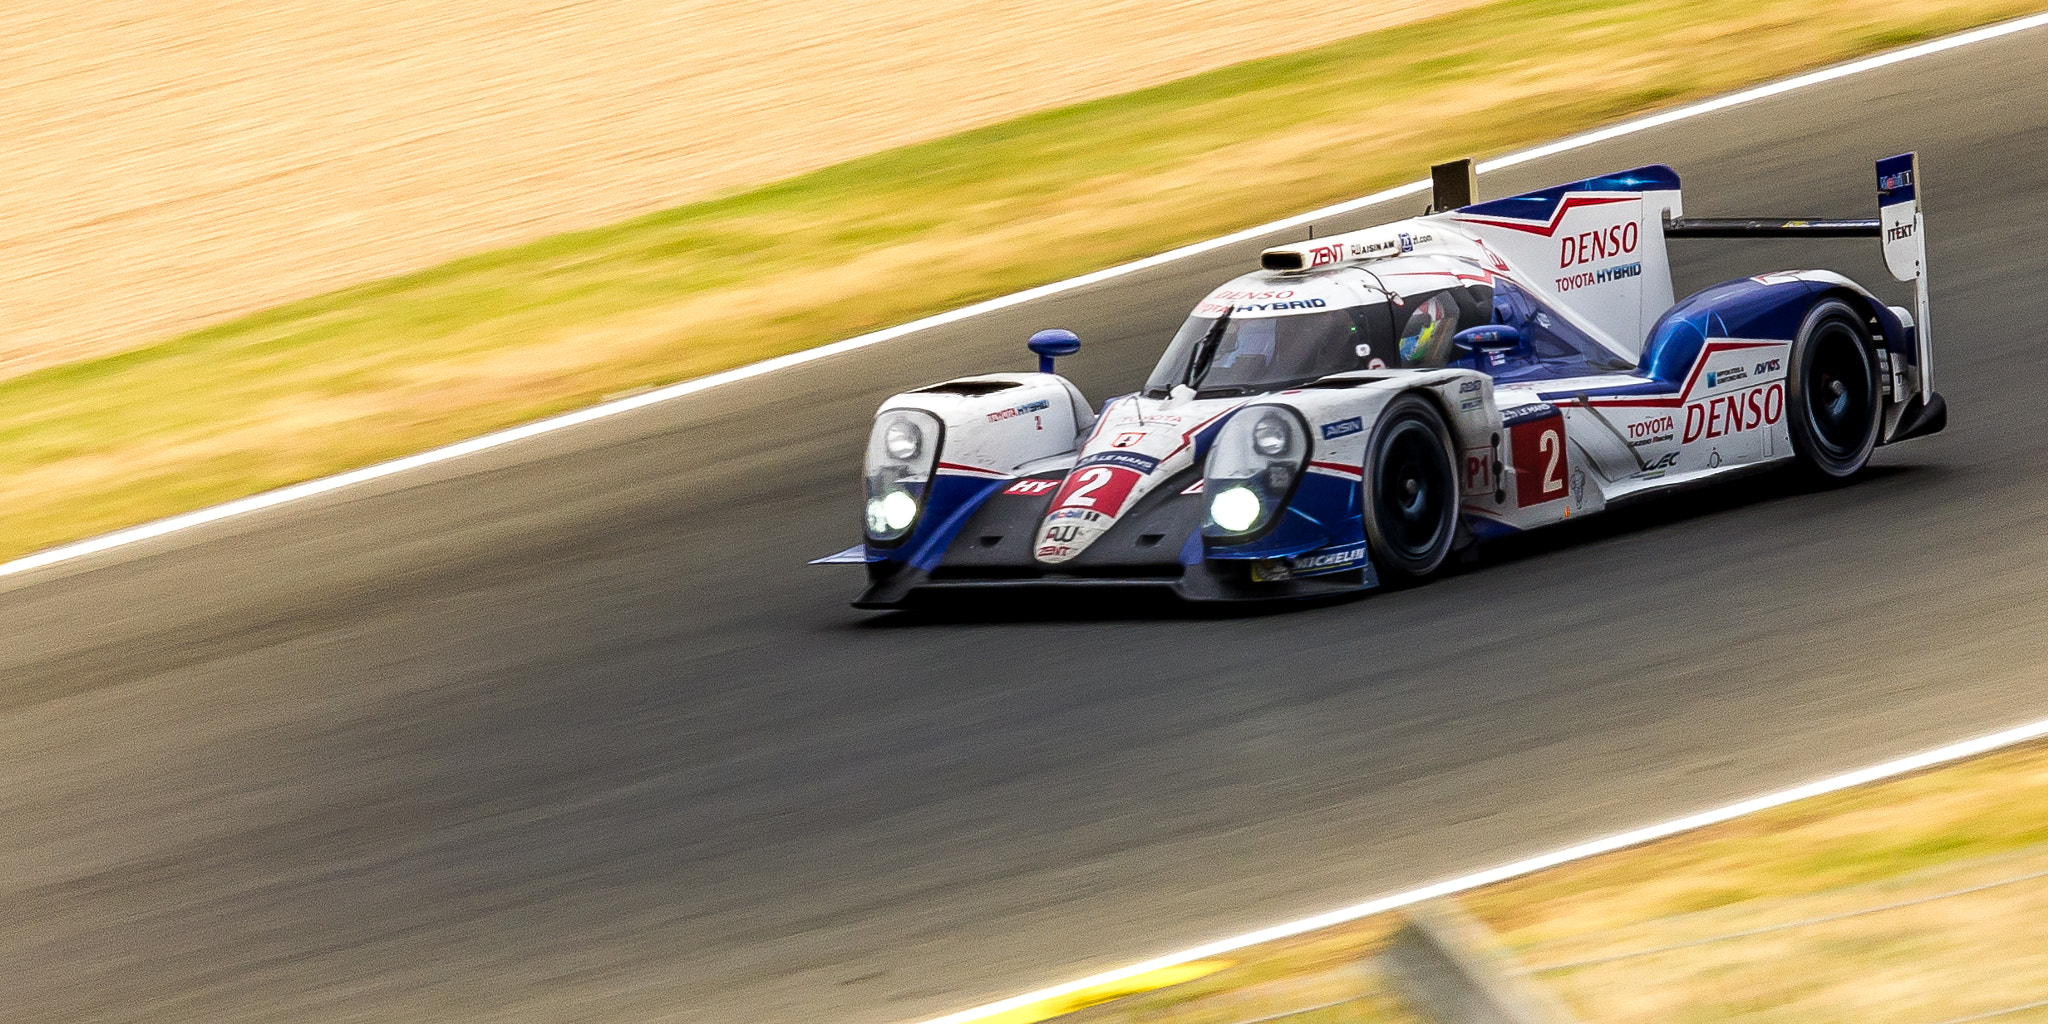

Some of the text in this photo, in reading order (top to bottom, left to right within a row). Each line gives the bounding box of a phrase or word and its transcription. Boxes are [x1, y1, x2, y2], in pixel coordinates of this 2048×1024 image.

[1887, 223, 1913, 244] JTEKT
[1308, 243, 1344, 268] ZENT
[1362, 242, 1382, 254] AISIN
[1383, 239, 1395, 249] AW
[1560, 221, 1638, 269] DENSO
[1555, 261, 1642, 293] TOYOTA HYBRID
[1214, 290, 1295, 300] DENSO
[1236, 298, 1327, 313] HYBRID
[1519, 407, 1529, 416] LE
[1528, 403, 1551, 414] MANS
[1681, 383, 1784, 445] DENSO
[1325, 419, 1361, 437] AISIN
[1627, 415, 1674, 439] TOYOTA
[1096, 454, 1115, 462] LE
[1113, 454, 1154, 468] MANS
[1466, 453, 1489, 489] P1
[1540, 429, 1563, 494] 2
[1640, 450, 1681, 472] WEC
[1008, 480, 1058, 493] HY
[1061, 467, 1114, 508] 2
[1037, 545, 1072, 557] ZENT
[1294, 547, 1367, 569] MICHELIN
